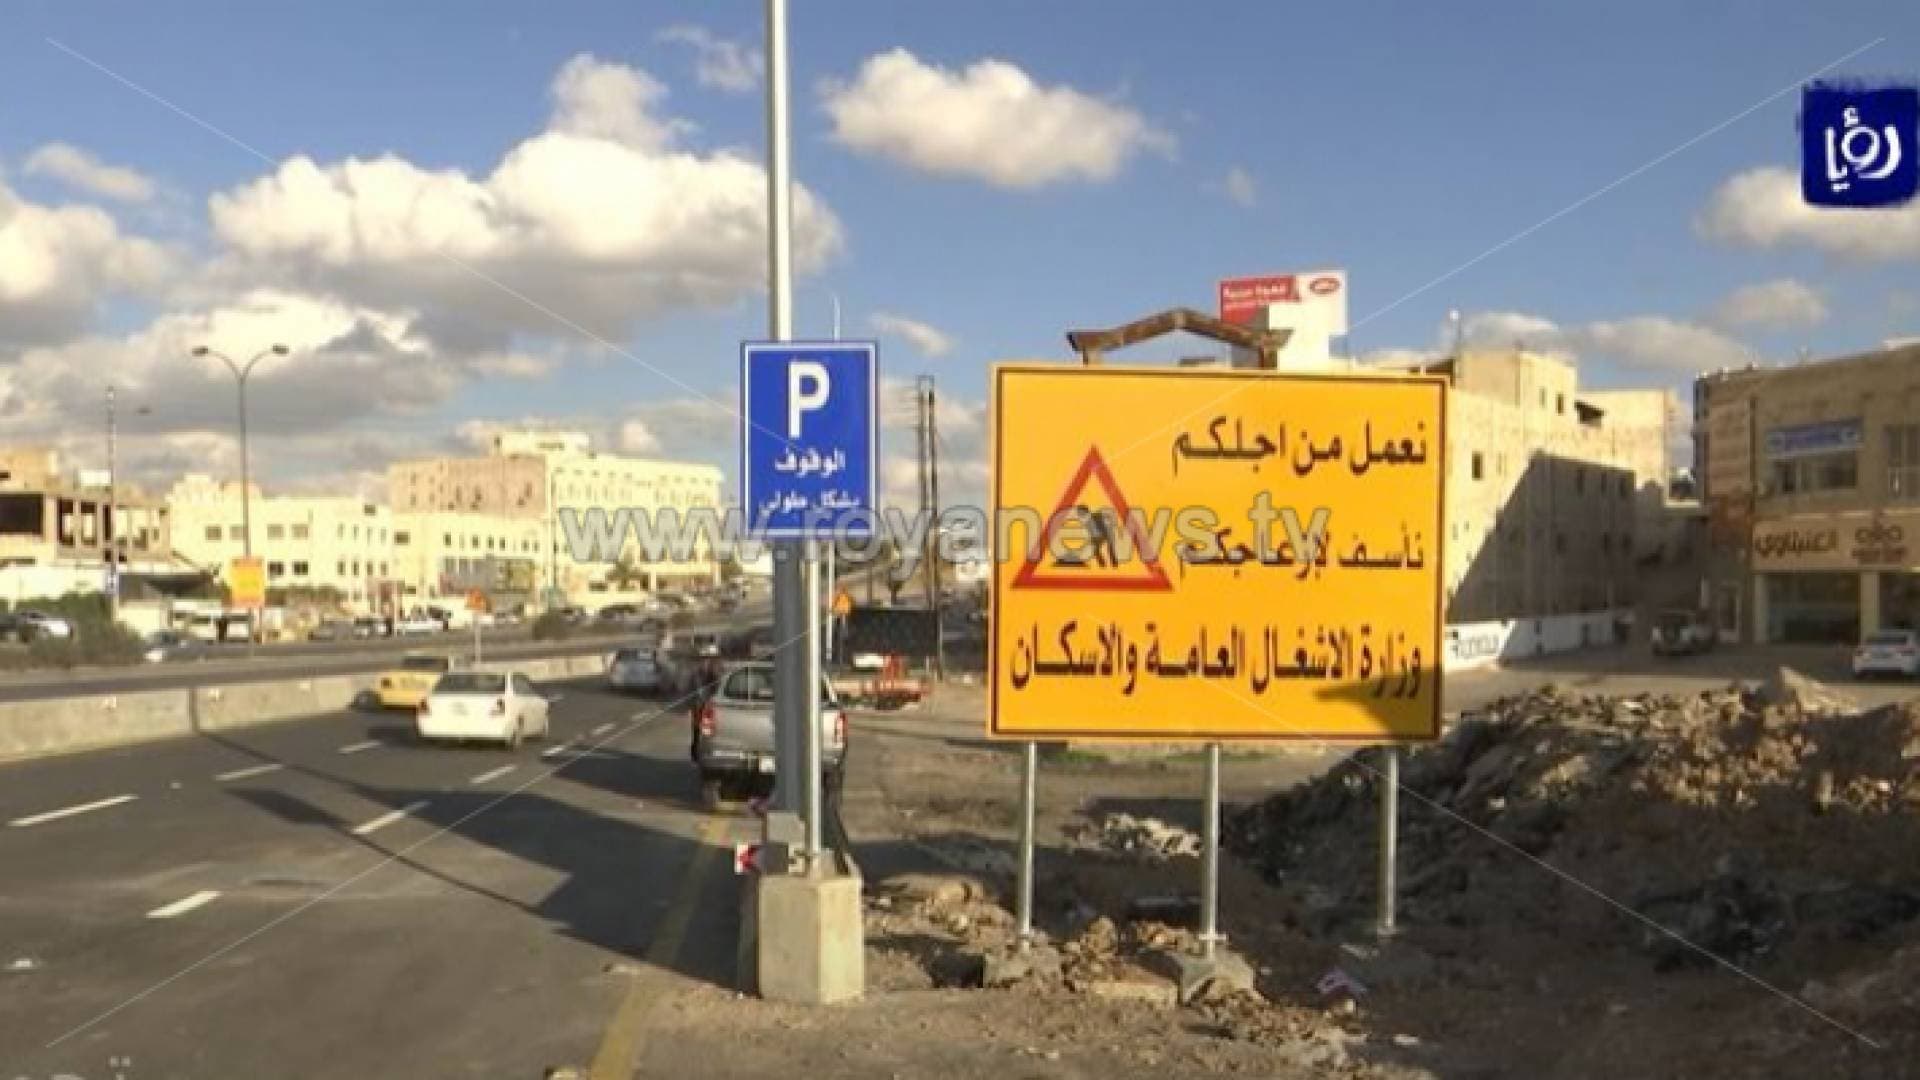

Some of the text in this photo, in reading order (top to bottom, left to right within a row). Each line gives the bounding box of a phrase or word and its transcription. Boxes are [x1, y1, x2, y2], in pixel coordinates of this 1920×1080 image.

[788, 361, 830, 439] P
[774, 447, 846, 478] الوقوف
[1171, 415, 1427, 478] نعمل من اجلكم
[1011, 620, 1422, 699] وزارة الاشغال العامة والاسكان
